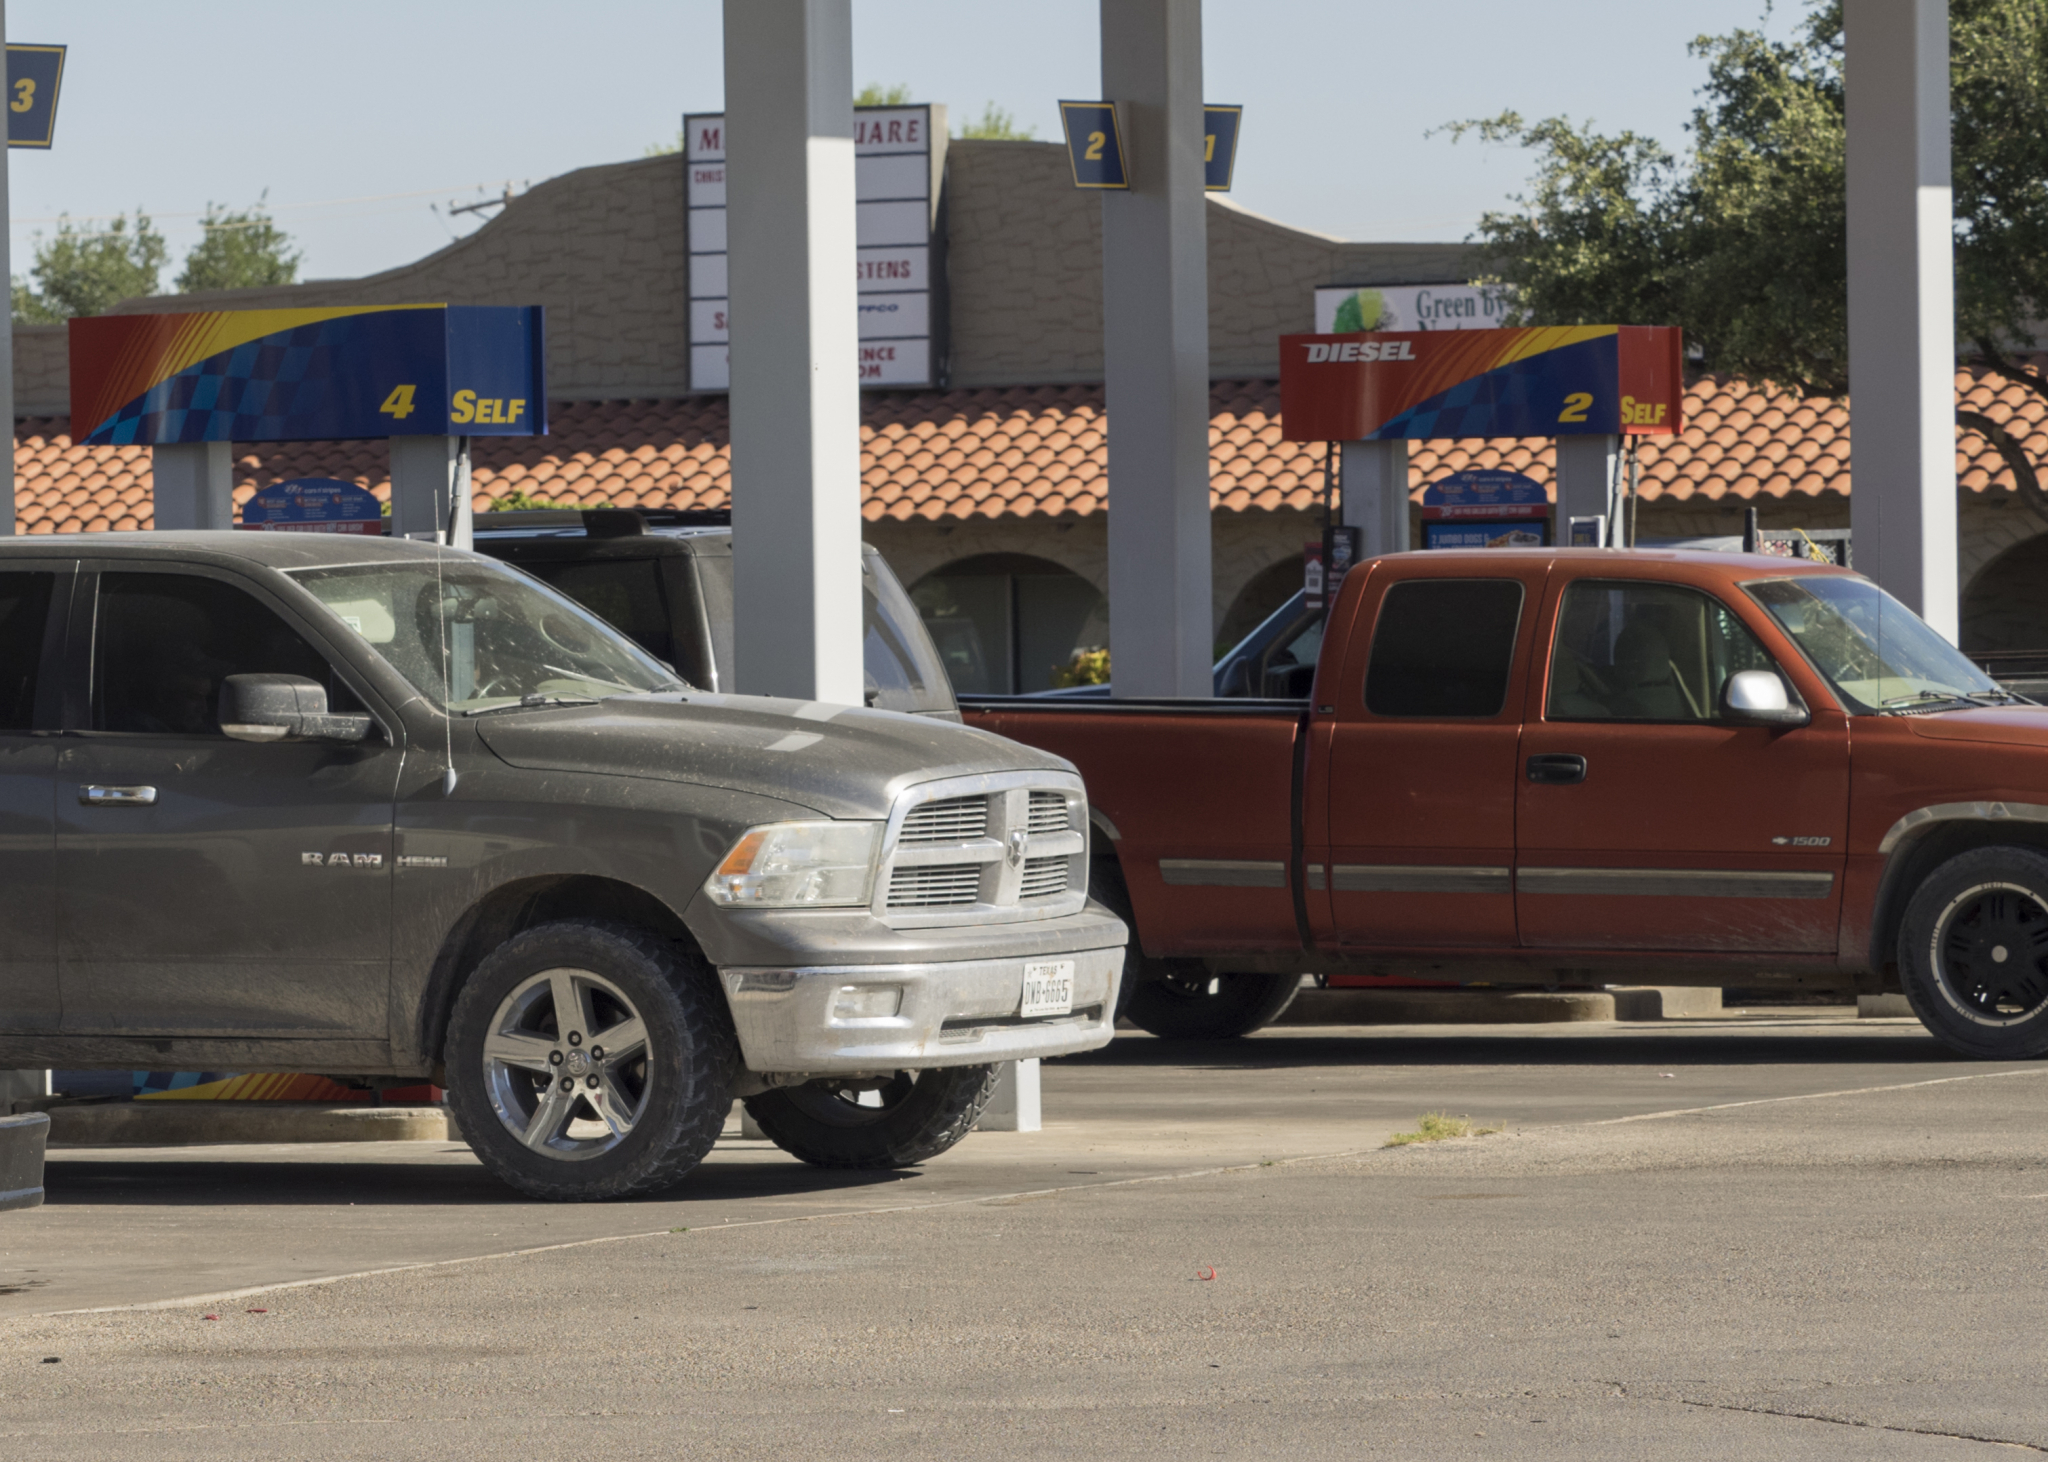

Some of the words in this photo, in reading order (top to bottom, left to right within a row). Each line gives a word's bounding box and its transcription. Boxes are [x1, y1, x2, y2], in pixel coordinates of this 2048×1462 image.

[10, 78, 36, 113] 3
[1084, 131, 1106, 160] 2
[1204, 134, 1216, 162] 1
[1416, 290, 1476, 319] Green
[1301, 341, 1416, 364] DIESEL
[379, 384, 417, 420] 4
[451, 389, 526, 424] SELF
[1557, 392, 1594, 423] 2
[1621, 396, 1667, 425] SELF
[1793, 836, 1832, 846] 1500
[301, 852, 383, 868] RAM
[397, 856, 448, 868] HEMI
[1039, 965, 1058, 976] TEXAS
